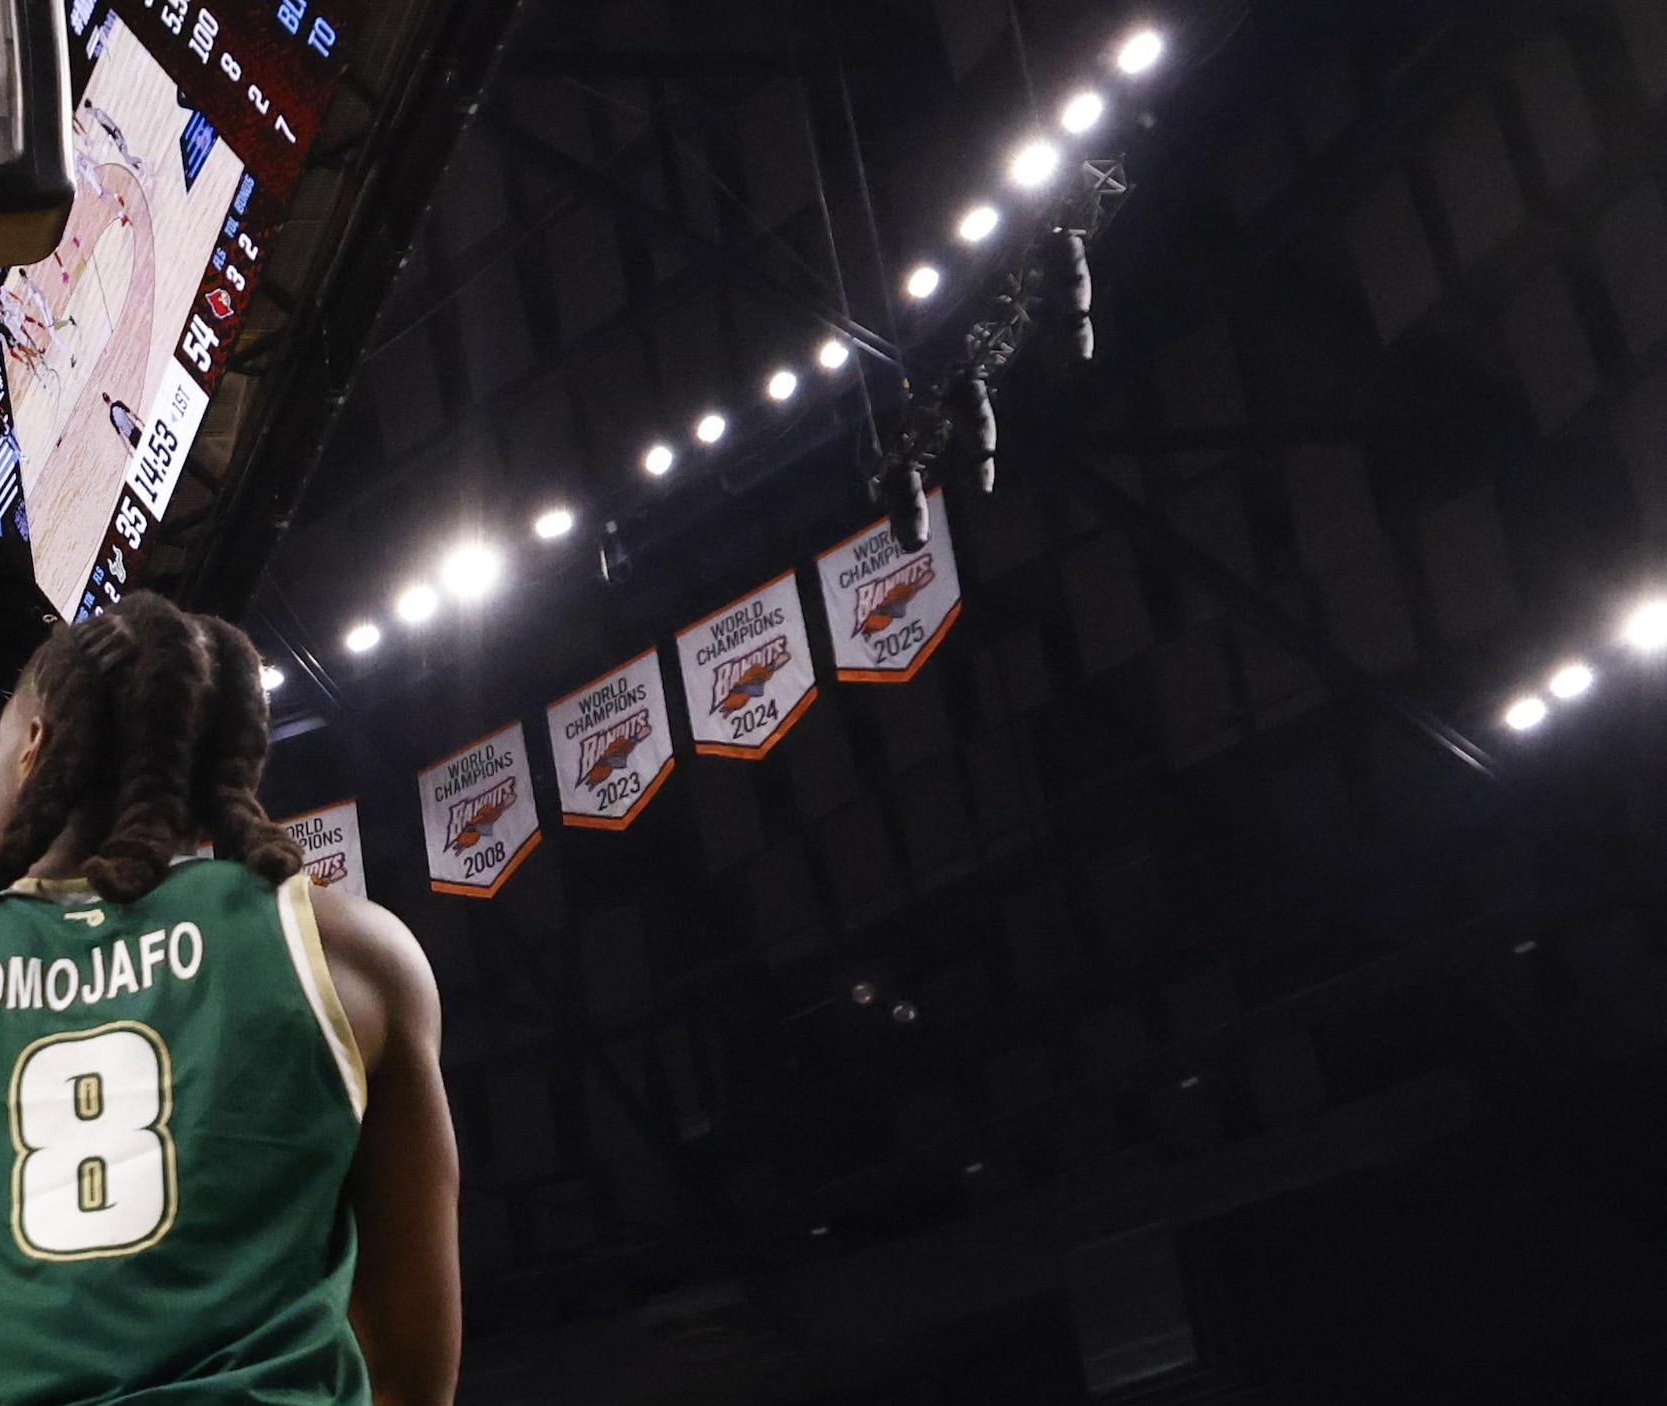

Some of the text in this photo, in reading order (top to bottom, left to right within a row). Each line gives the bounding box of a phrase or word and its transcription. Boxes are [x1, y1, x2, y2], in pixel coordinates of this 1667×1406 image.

[188, 8, 219, 64] 100
[307, 16, 337, 58] TO
[220, 52, 242, 82] 8
[247, 84, 269, 115] 2
[274, 114, 297, 143] 7
[238, 233, 259, 260] 2
[226, 264, 247, 291] 3
[181, 312, 220, 372] 54
[172, 384, 192, 419] 1ST
[134, 418, 178, 502] 14:53
[115, 495, 148, 550] 35
[853, 530, 892, 561] WOR
[696, 609, 785, 666] CHAMPIONS
[710, 601, 764, 639] WORLD
[875, 619, 924, 664] 2025
[566, 685, 647, 739] CHAMPIONS
[579, 677, 627, 714] WORLD
[731, 699, 779, 739] 2024
[435, 752, 513, 802] CHAMPIONS
[448, 744, 495, 778] WORLD
[597, 772, 641, 811] 2023
[463, 842, 505, 879] 2008
[8, 1020, 178, 1263] 8
